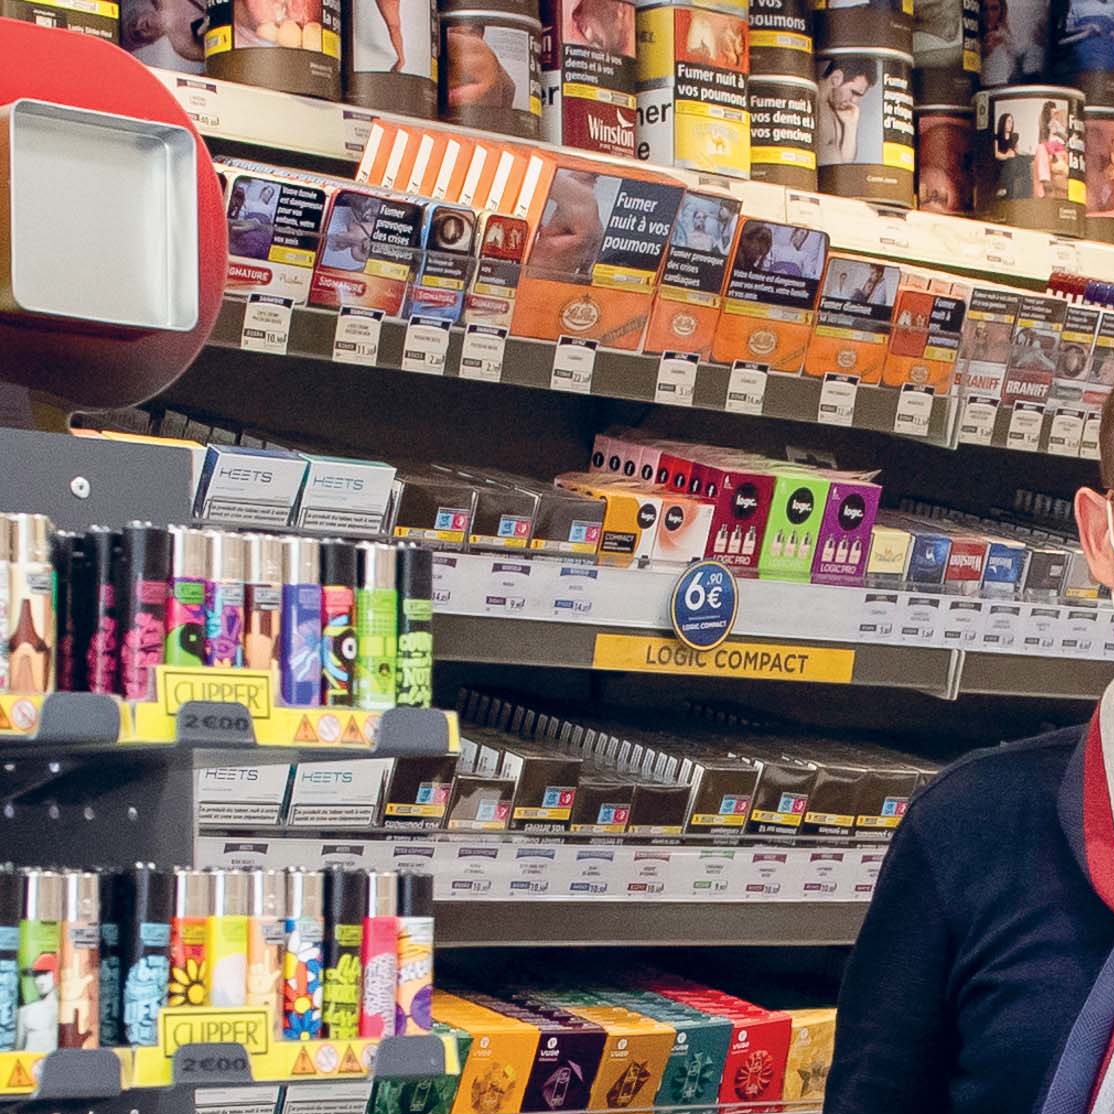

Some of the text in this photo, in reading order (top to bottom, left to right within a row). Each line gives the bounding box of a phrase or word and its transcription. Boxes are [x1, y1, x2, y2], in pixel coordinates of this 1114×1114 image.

[565, 58, 588, 70] dents
[678, 64, 745, 89] Fumer nuit à
[678, 84, 746, 107] vos poumons
[750, 95, 786, 107] Fumer
[788, 98, 806, 111] nuit
[750, 112, 770, 122] vos
[773, 111, 801, 126] dents
[588, 113, 634, 148] Winston
[750, 128, 812, 144] vos gencives
[617, 192, 658, 213] Fumer
[609, 214, 670, 236] nuit à vos
[602, 236, 662, 256] poumons
[1006, 380, 1049, 397] BRANIFF
[219, 467, 273, 484] HEETS
[313, 476, 364, 491] HEETS
[646, 645, 808, 674] LOGIC COMPACT
[205, 768, 258, 781] HEETS
[301, 771, 353, 783] HEETS
